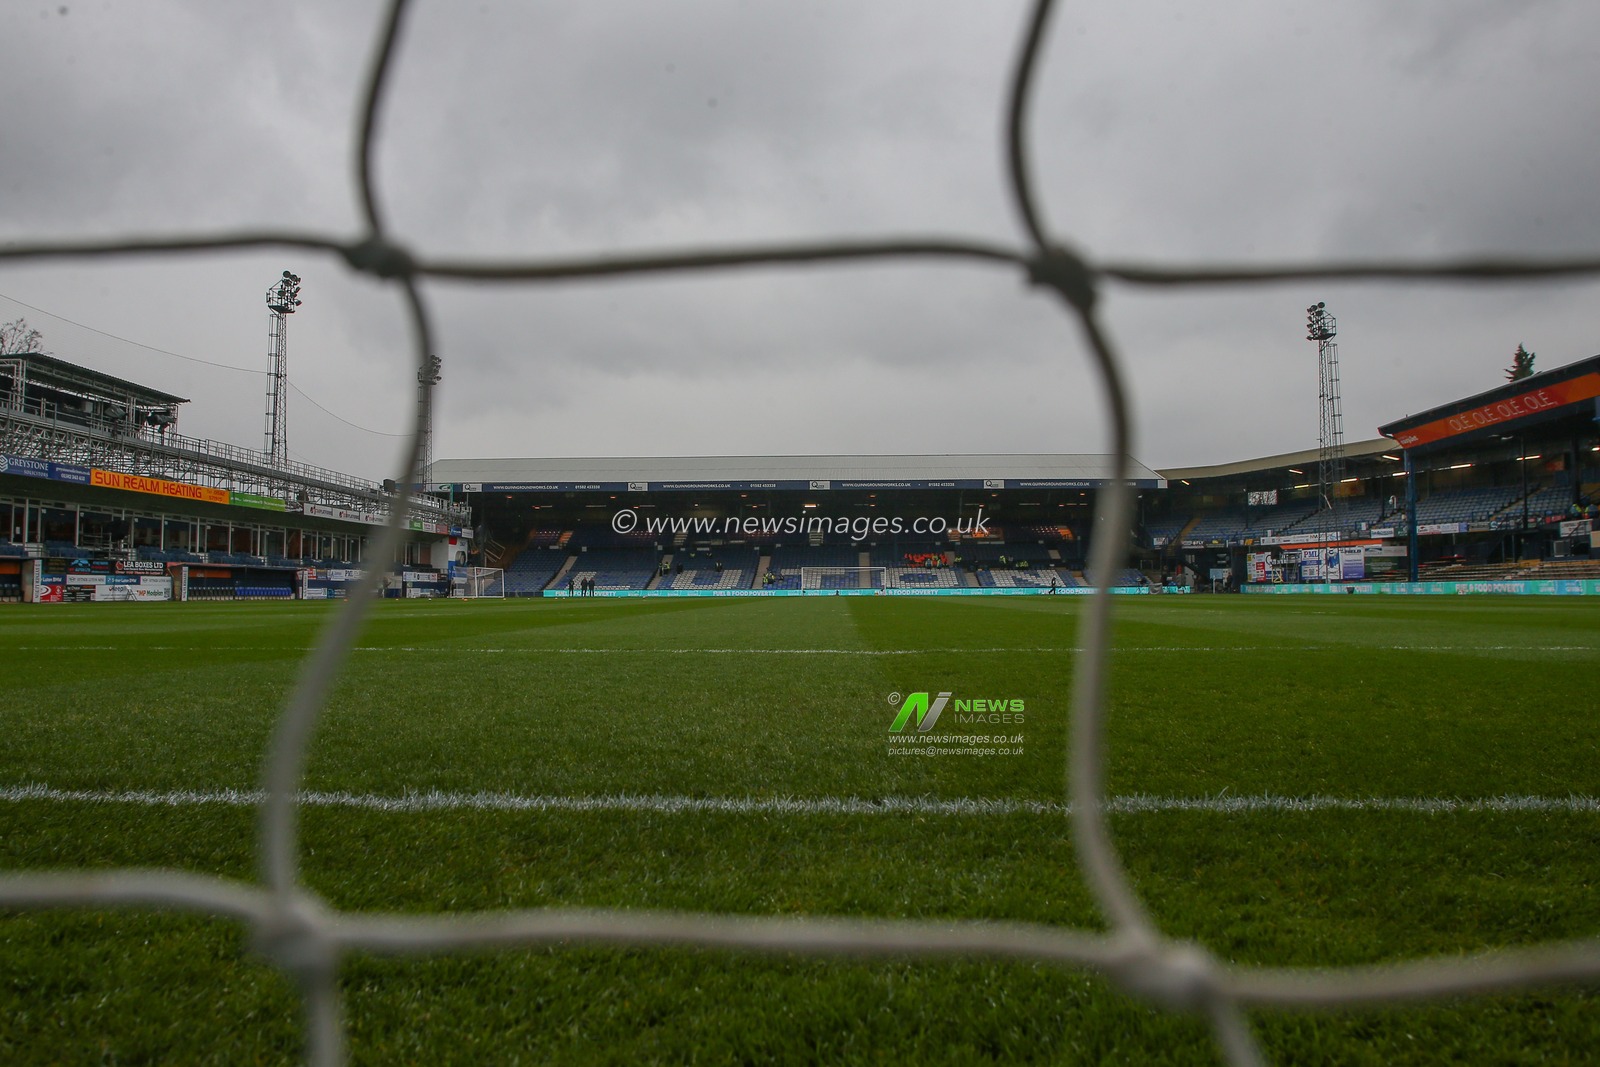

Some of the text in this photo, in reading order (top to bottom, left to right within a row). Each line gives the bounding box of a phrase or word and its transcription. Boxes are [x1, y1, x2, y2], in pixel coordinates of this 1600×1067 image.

[8, 458, 49, 471] GREYSTONE
[95, 471, 120, 487] SUN
[123, 478, 160, 493] REALM
[163, 483, 202, 498] HEATING
[1455, 584, 1470, 593] FUEL
[1474, 583, 1492, 593] FOOD
[1493, 583, 1525, 593] POVERTY
